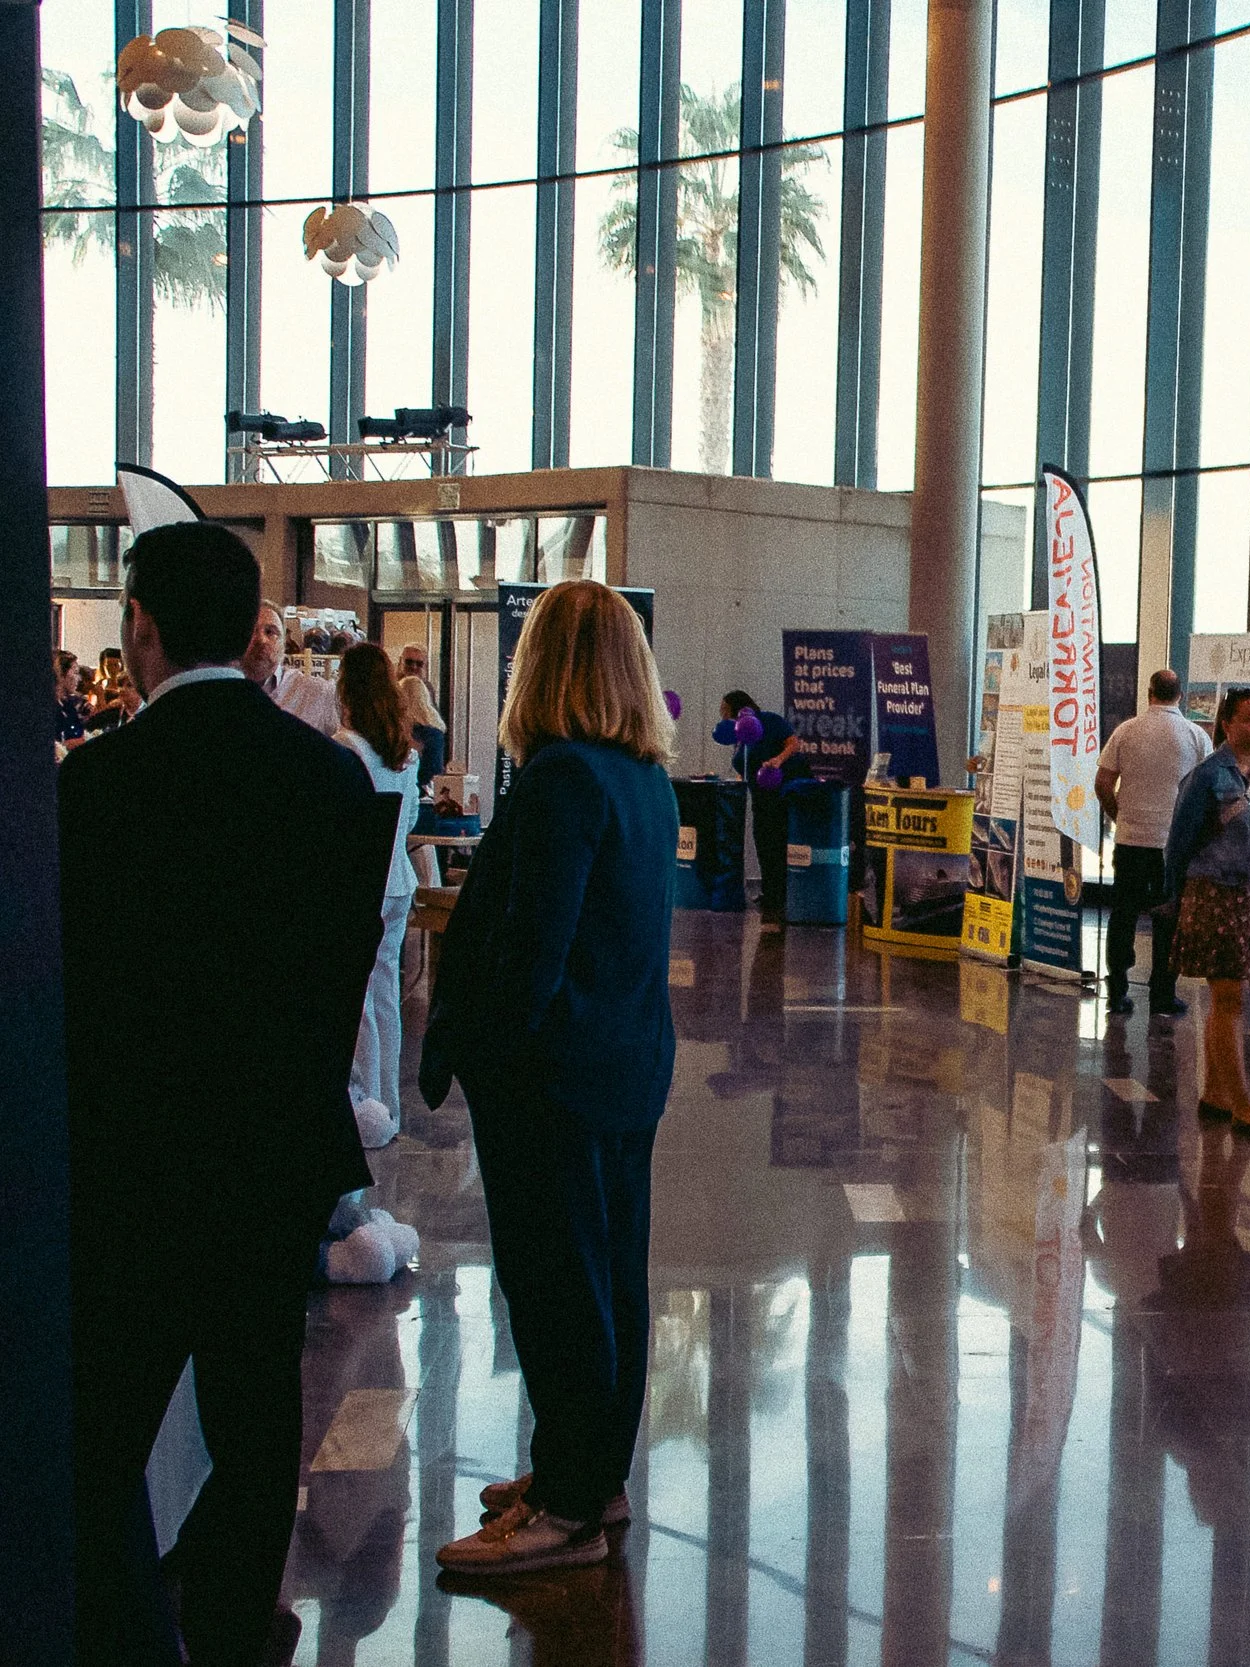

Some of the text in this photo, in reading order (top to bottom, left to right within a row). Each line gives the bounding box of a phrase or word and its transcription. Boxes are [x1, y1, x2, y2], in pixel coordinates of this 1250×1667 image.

[794, 645, 834, 661] Plans
[794, 663, 855, 679] at prices
[794, 679, 825, 694] that
[877, 680, 930, 696] Funeral Plan
[793, 697, 835, 711] won't
[787, 706, 865, 738] break
[798, 738, 856, 755] he bank
[892, 798, 940, 833] Tours
